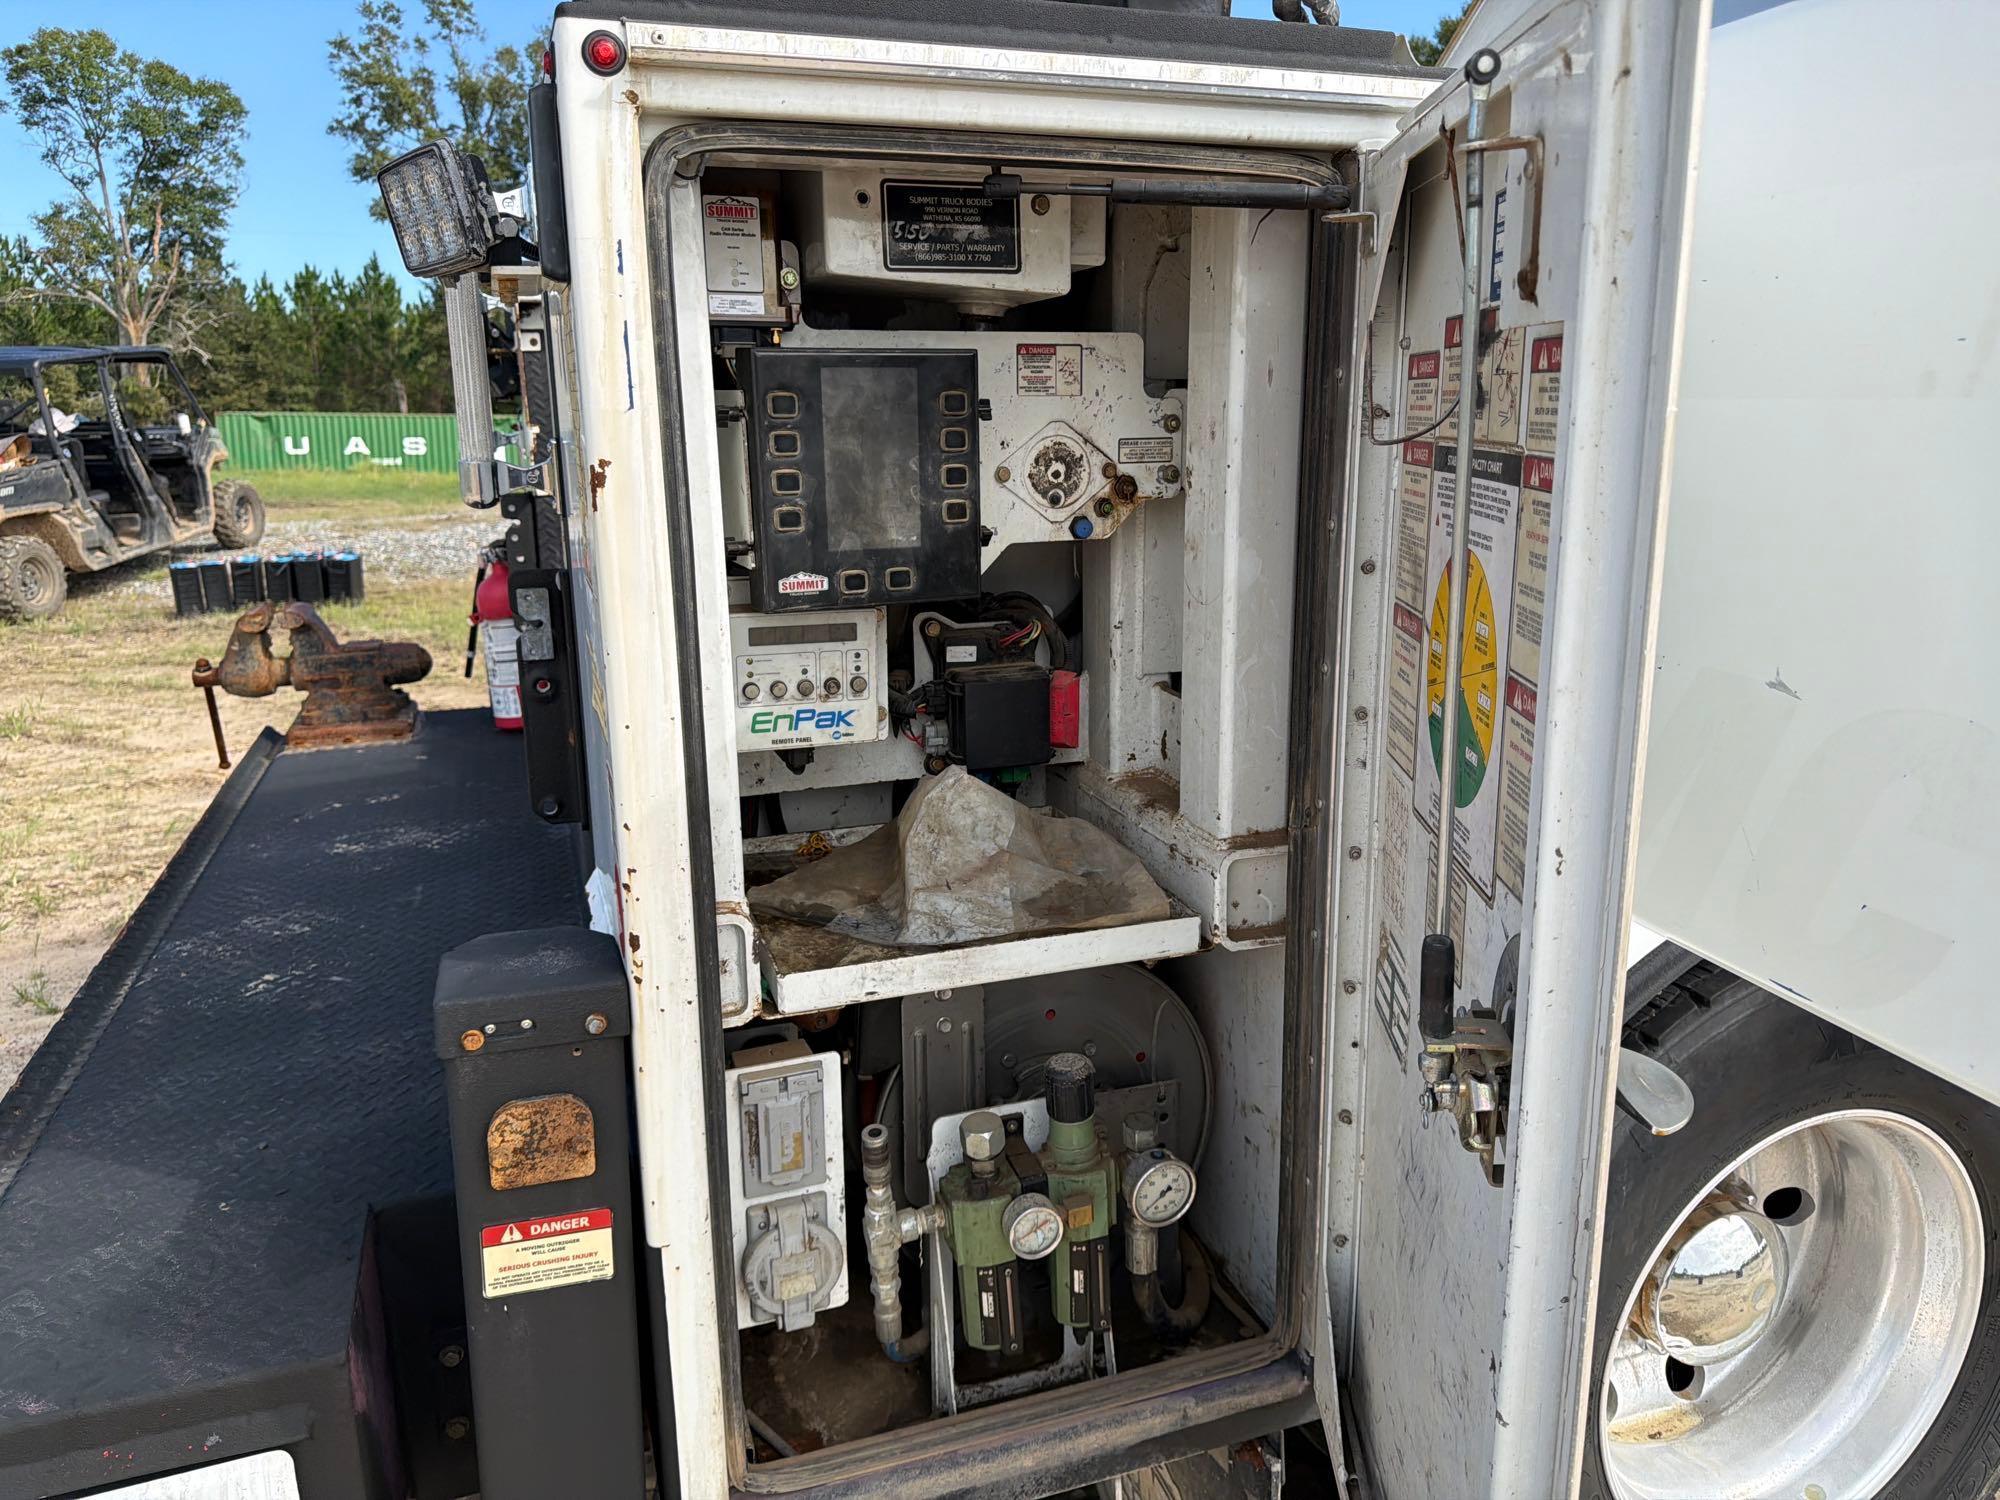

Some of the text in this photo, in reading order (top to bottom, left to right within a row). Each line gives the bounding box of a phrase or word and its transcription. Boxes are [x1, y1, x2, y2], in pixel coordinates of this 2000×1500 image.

[909, 195, 993, 206] SUMMIT TRUCK BODIES
[707, 205, 755, 218] SUMMIT
[899, 242, 930, 251] SERVICE
[937, 244, 960, 252] PARTS
[967, 244, 1006, 252] WARRANTY
[974, 254, 991, 262] 7760
[1418, 360, 1435, 374] DANGER
[1413, 448, 1428, 460] DANGER
[1472, 458, 1486, 472] PACITY
[1487, 461, 1503, 474] CHART
[781, 579, 826, 591] SUMMIT
[750, 708, 857, 734] EnPak
[530, 1217, 590, 1235] DANGER
[521, 1243, 545, 1252] MOVING
[546, 1238, 580, 1248] OUTRIGGER
[499, 1251, 598, 1272] SERIOUS CRUSHING INJURY
